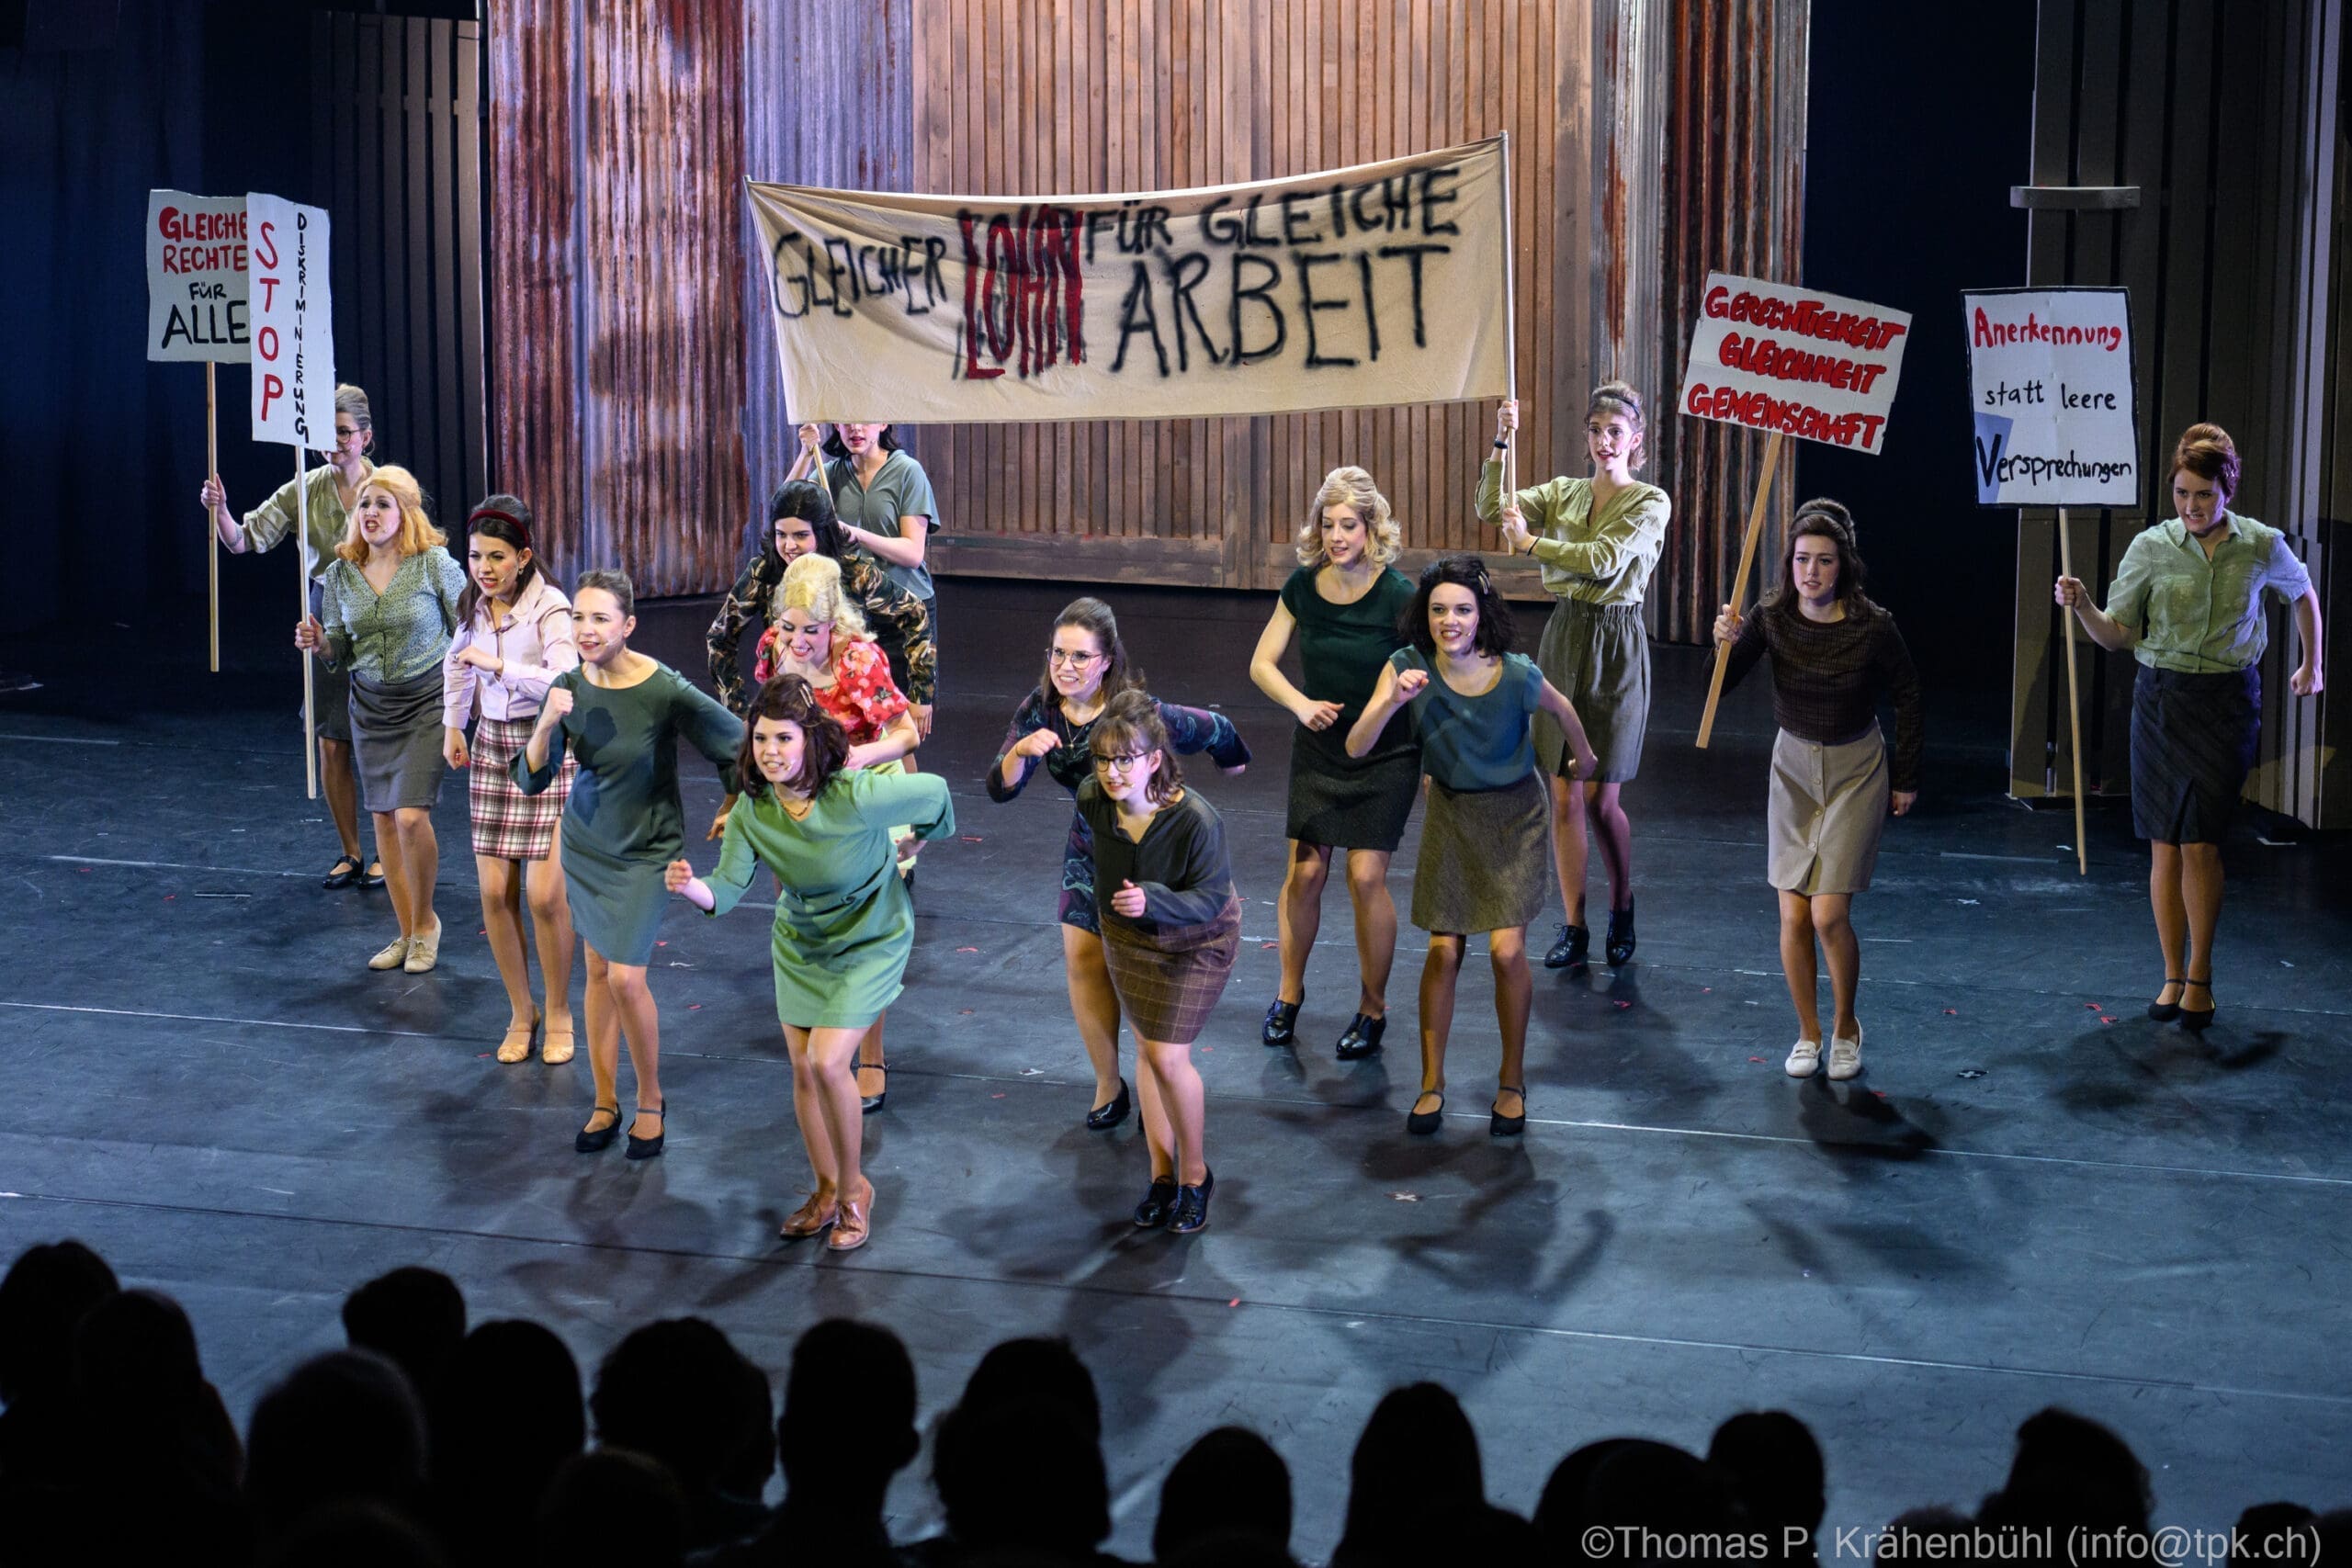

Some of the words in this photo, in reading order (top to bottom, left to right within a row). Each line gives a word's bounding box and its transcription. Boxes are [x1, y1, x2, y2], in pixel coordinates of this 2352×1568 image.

[159, 206, 248, 243] GLEICHE
[773, 231, 947, 319] GLEICHER
[1085, 200, 1173, 264] FÜR
[1199, 167, 1461, 249] GLEICHE
[163, 244, 248, 275] RECHTE
[188, 281, 227, 301] FÜR
[1108, 244, 1451, 378] ARBEIT
[1704, 286, 1907, 350] GERECHTIGKEIT
[162, 299, 251, 349] ALLE
[254, 221, 284, 422] STOP
[1974, 306, 2122, 352] Anerkennung
[1718, 331, 1887, 395] GLEICHHEIT
[1687, 382, 1885, 448] GEMEINSCHAFT
[1984, 379, 2044, 406] statt
[2061, 382, 2117, 410] leere
[1976, 434, 2132, 488] Versprechungen
